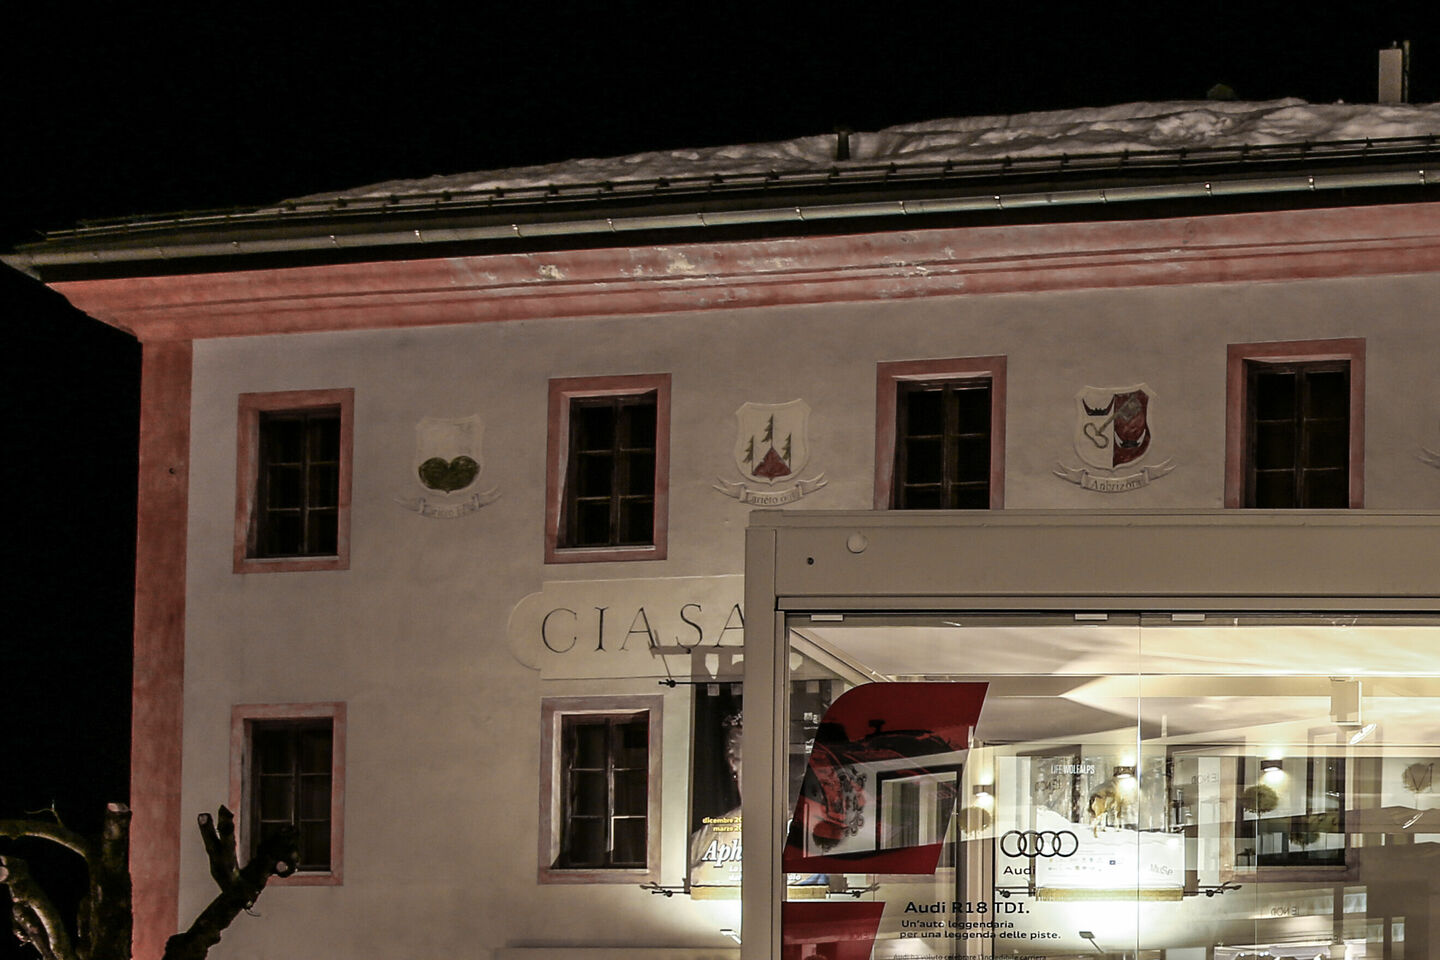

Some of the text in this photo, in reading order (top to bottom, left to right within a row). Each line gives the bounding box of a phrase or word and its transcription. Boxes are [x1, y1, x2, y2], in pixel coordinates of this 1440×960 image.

[542, 603, 745, 654] CIASA
[904, 901, 1031, 915] Audi R18 TDI.
[901, 919, 945, 929] Un'auto
[899, 931, 918, 940] per
[920, 931, 942, 939] una
[999, 931, 1027, 939] delle
[1030, 931, 1062, 941] piste.
